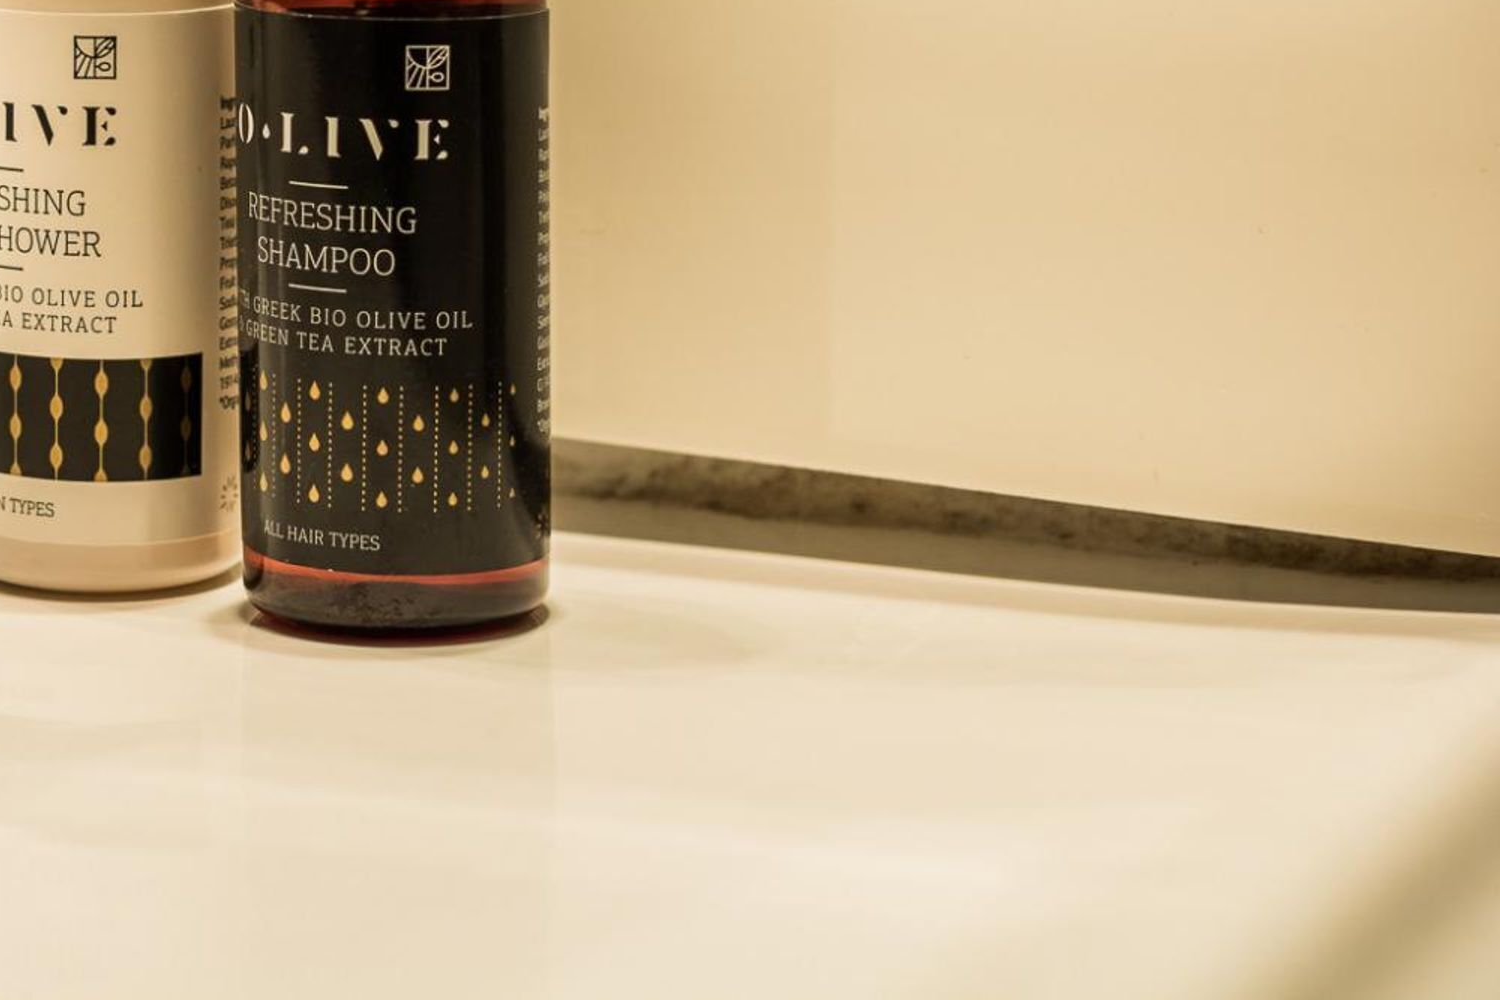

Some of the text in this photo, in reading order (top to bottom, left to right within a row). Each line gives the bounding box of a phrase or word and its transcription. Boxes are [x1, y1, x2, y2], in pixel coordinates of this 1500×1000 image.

[248, 191, 418, 235] REFRESHING
[257, 236, 396, 277] SHAMPOO
[31, 287, 96, 309] OLIVE
[105, 290, 143, 309] OIL
[253, 295, 302, 323] GREEK
[310, 306, 347, 327] BIO
[356, 311, 426, 331] OLIVE
[436, 310, 473, 330] OIL
[22, 312, 117, 334] EXTRACT
[246, 318, 289, 346] GREEN
[297, 331, 334, 353] TEA
[345, 336, 448, 357] EXTRACT
[9, 498, 55, 518] TYPES
[264, 519, 381, 551] ALL HAIR TYPES
